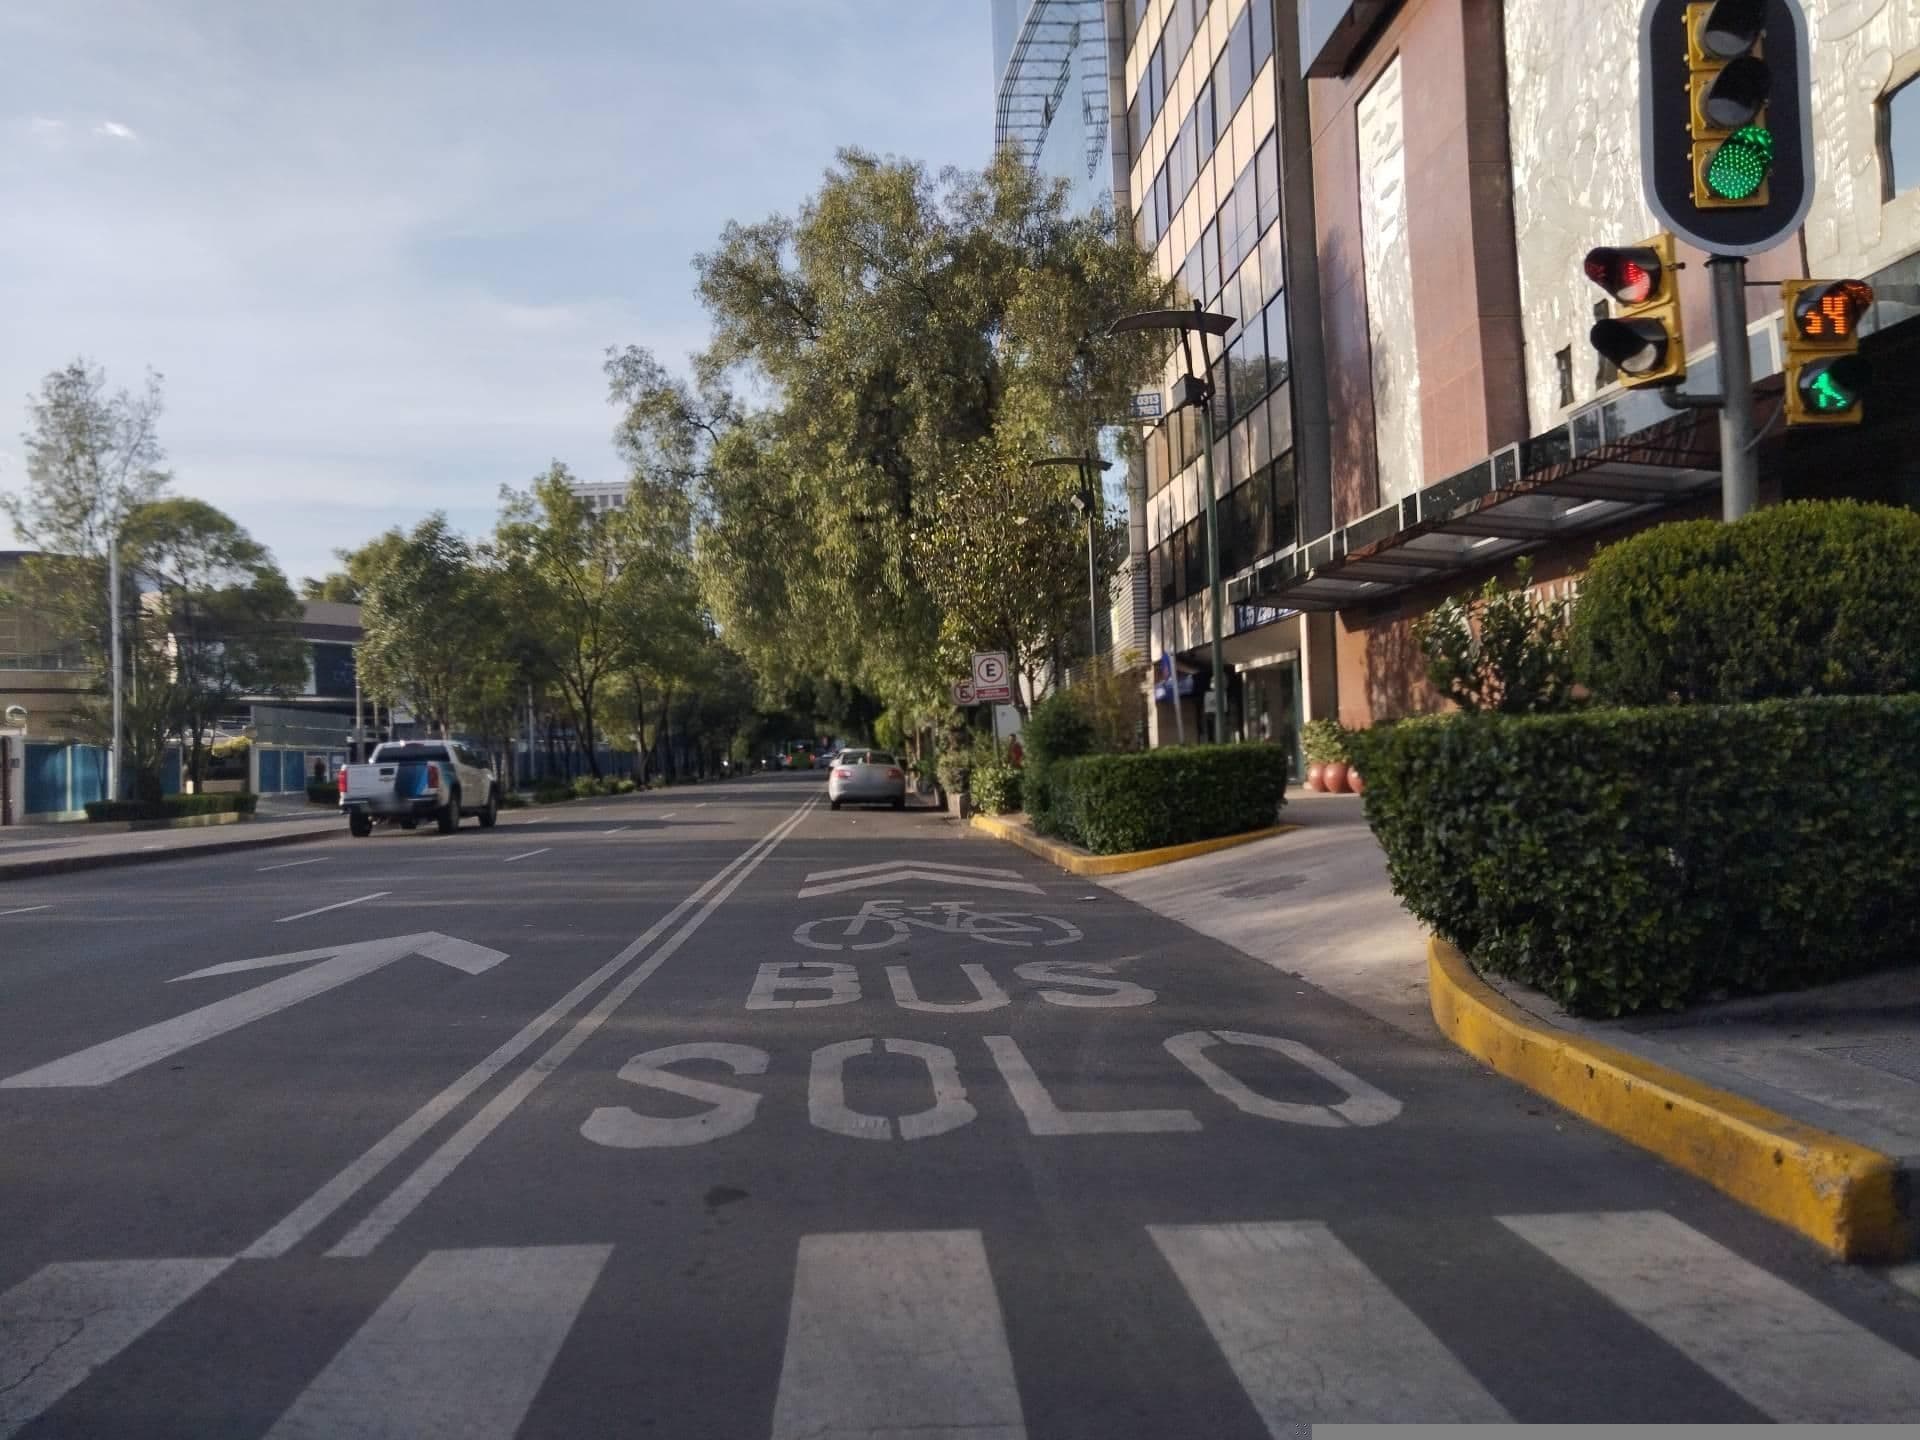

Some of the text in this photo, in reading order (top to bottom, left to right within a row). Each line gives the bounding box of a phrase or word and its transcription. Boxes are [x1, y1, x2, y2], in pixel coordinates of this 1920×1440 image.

[986, 663, 996, 677] E
[745, 960, 1157, 1014] BUS
[580, 1030, 1403, 1149] SOLO
